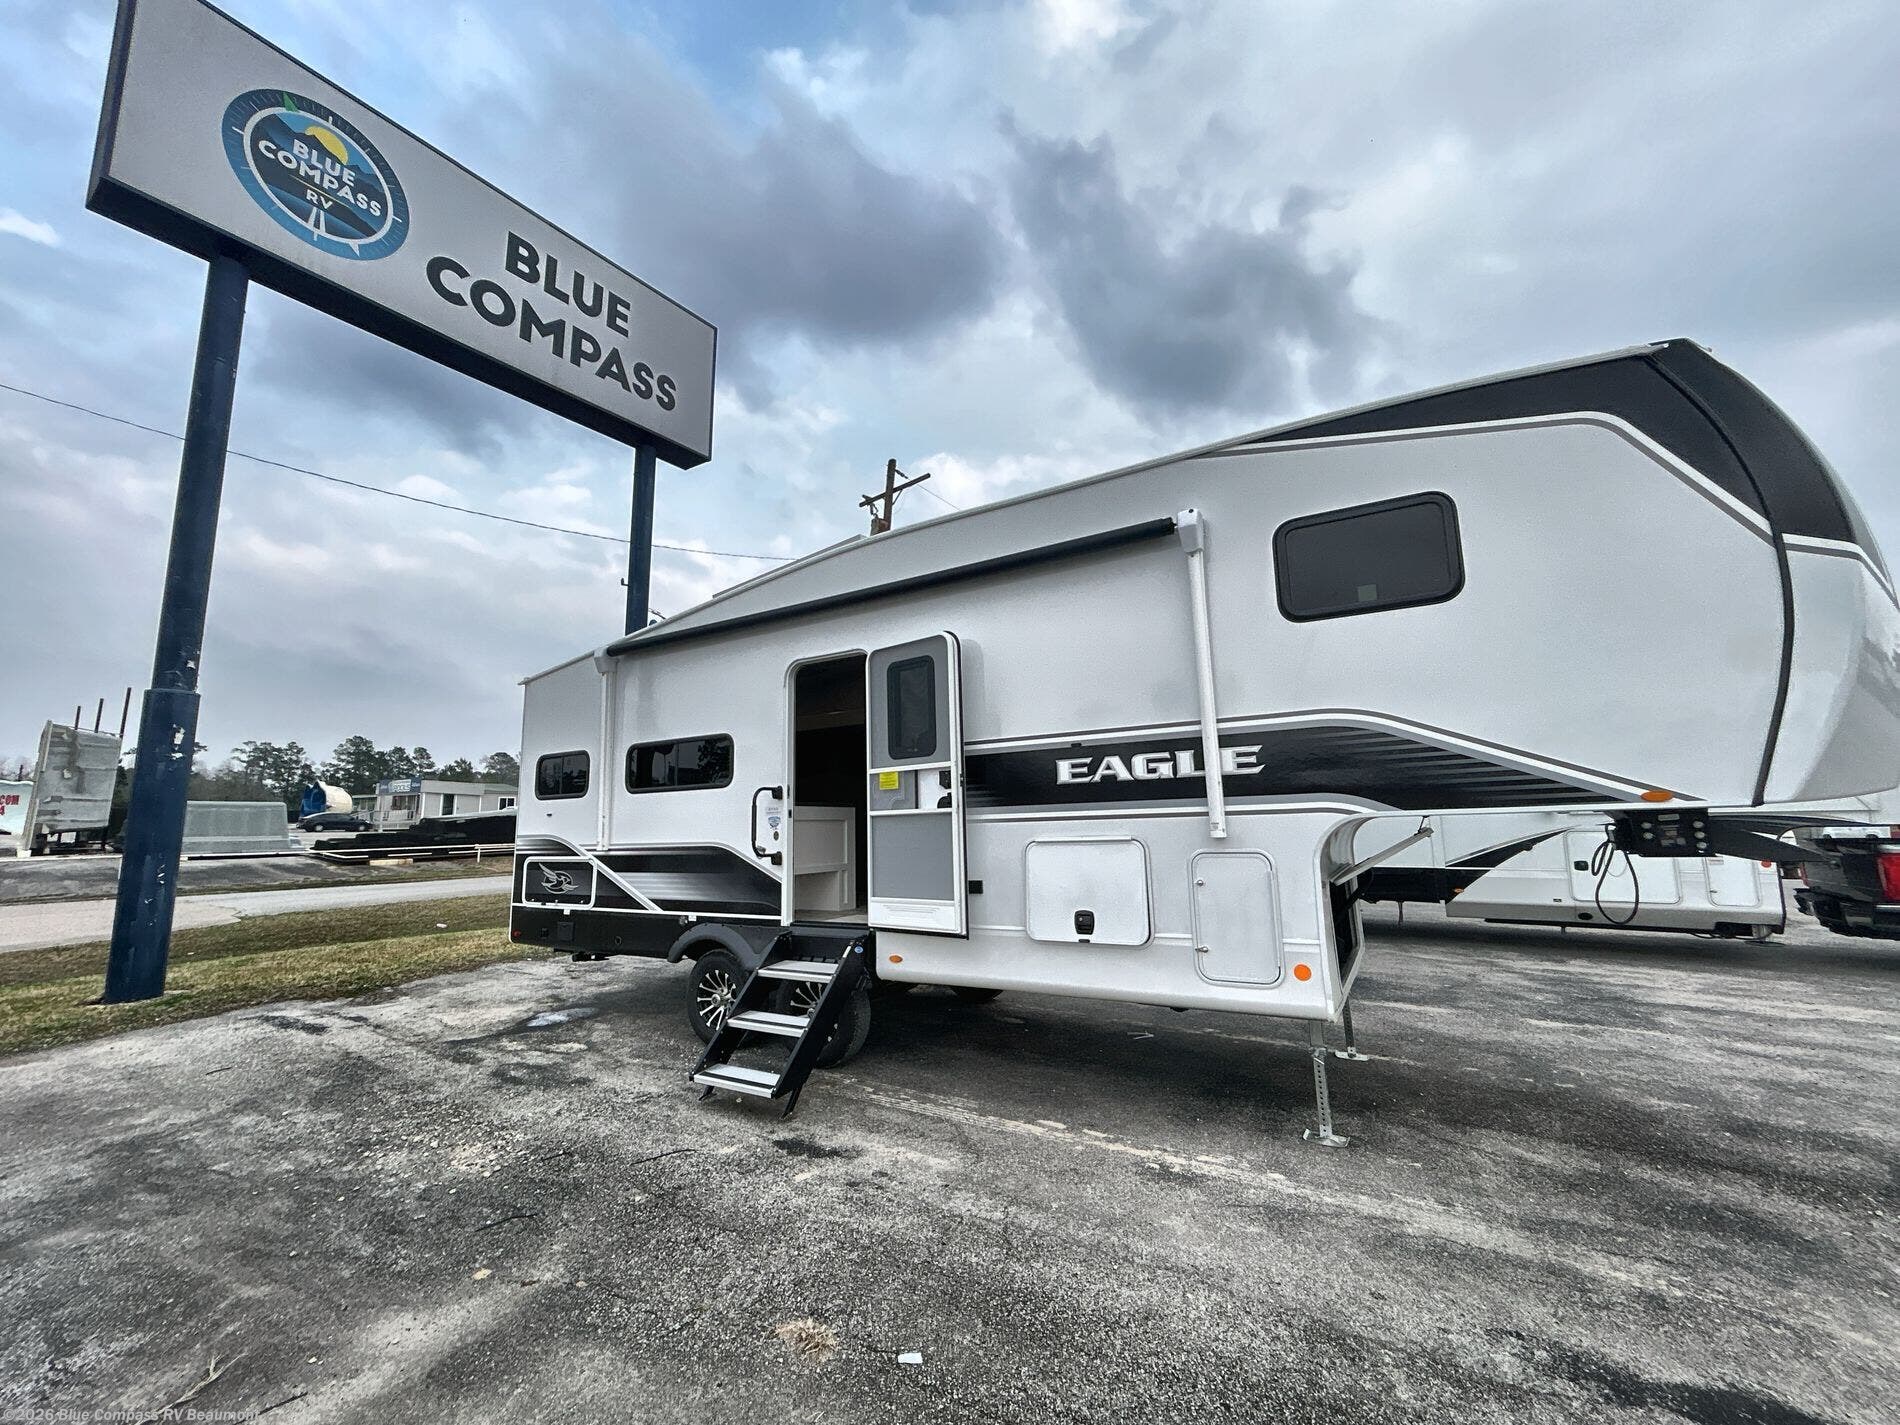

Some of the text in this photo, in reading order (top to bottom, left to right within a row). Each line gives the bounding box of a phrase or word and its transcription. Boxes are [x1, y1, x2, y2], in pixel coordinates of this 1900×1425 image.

[258, 140, 382, 217] COMPASS
[292, 139, 356, 187] BLUE
[306, 189, 333, 210] RV
[505, 230, 631, 338] BLUE
[426, 256, 677, 411] COMPASS
[1055, 745, 1265, 785] EAGLE
